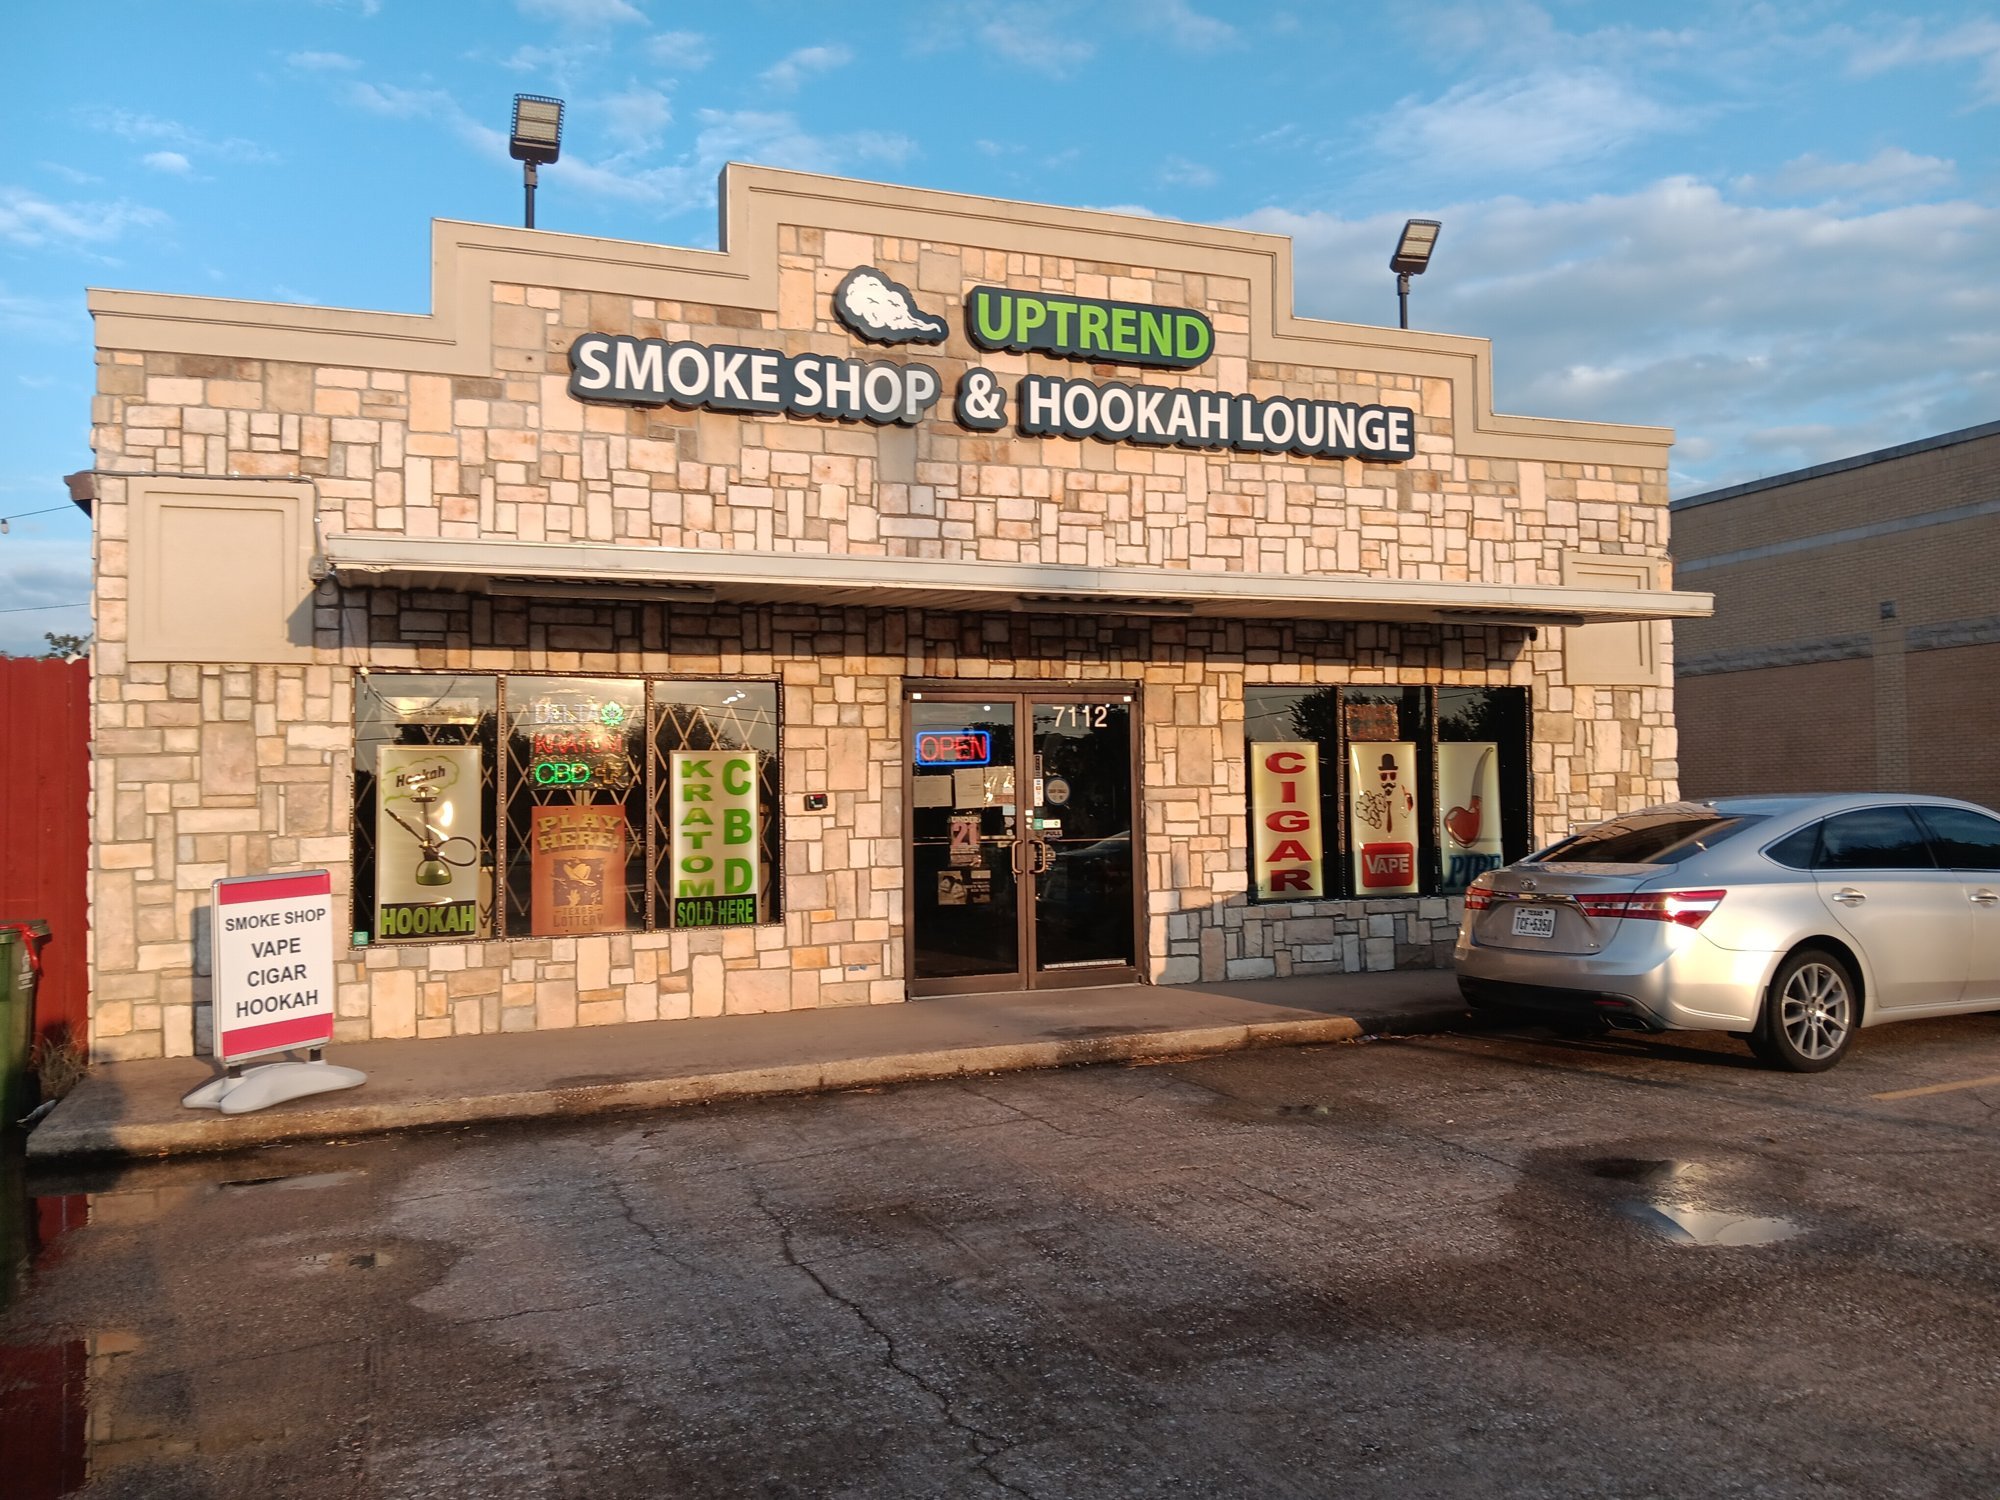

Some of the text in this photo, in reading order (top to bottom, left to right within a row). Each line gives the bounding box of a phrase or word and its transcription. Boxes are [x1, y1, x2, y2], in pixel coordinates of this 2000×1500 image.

[977, 293, 1210, 360] UPTREND
[578, 340, 1410, 453] SMOKE SHOP & HOOKAH LOUNGE
[1052, 706, 1108, 728] 7112
[919, 735, 987, 761] OPEN
[535, 762, 591, 785] CBD
[537, 814, 621, 834] PLAY
[679, 760, 716, 898] KRATOM
[722, 759, 753, 895] CBD
[1264, 751, 1314, 892] CIGAR
[951, 822, 978, 848] 21
[1365, 853, 1410, 875] VAPE
[225, 908, 327, 932] SMOKE SHOP
[380, 905, 476, 936] HOOKAH
[553, 914, 604, 928] LOTTERY
[562, 906, 594, 916] TEXAS
[677, 898, 754, 928] SOLD HERE
[251, 937, 302, 959] VAPE
[246, 964, 308, 987] CIGAR
[235, 989, 319, 1019] HOOKAH
